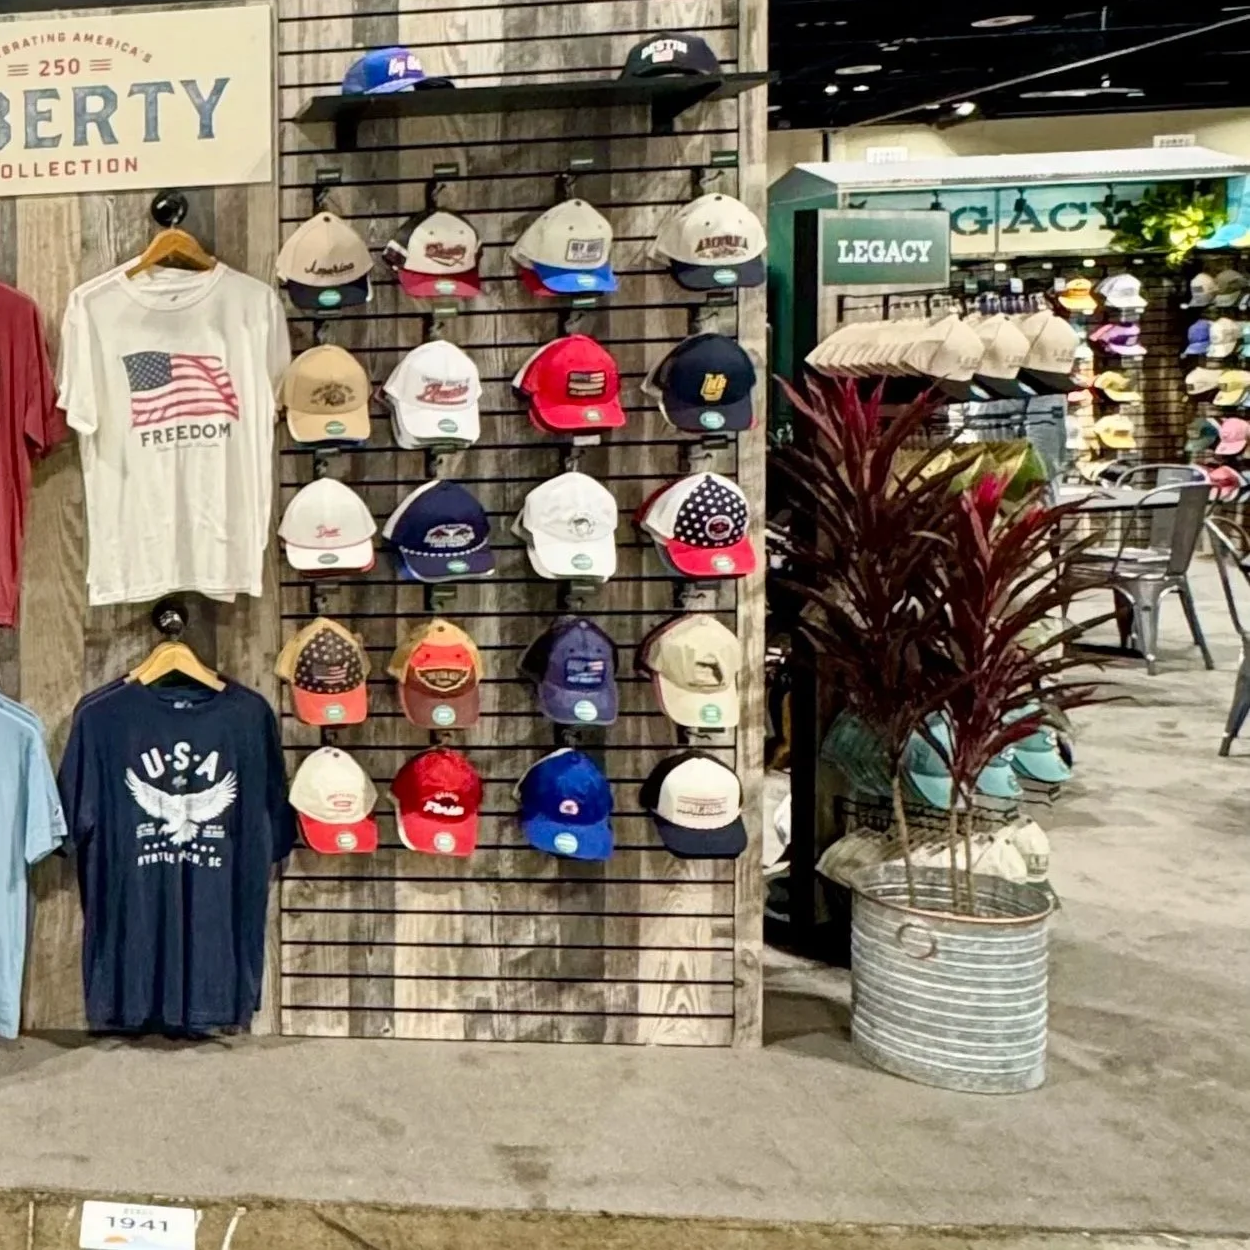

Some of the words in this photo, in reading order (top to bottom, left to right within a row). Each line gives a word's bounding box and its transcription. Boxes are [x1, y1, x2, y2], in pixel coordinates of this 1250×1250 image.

[72, 32, 153, 64] AMERICA'S
[38, 57, 81, 77] 250
[949, 200, 1127, 235] GACY
[837, 239, 933, 264] LEGACY
[140, 422, 232, 448] FREEDOM
[137, 850, 176, 867] MYRTLE
[207, 856, 222, 868] SC
[104, 1215, 169, 1232] 1941
